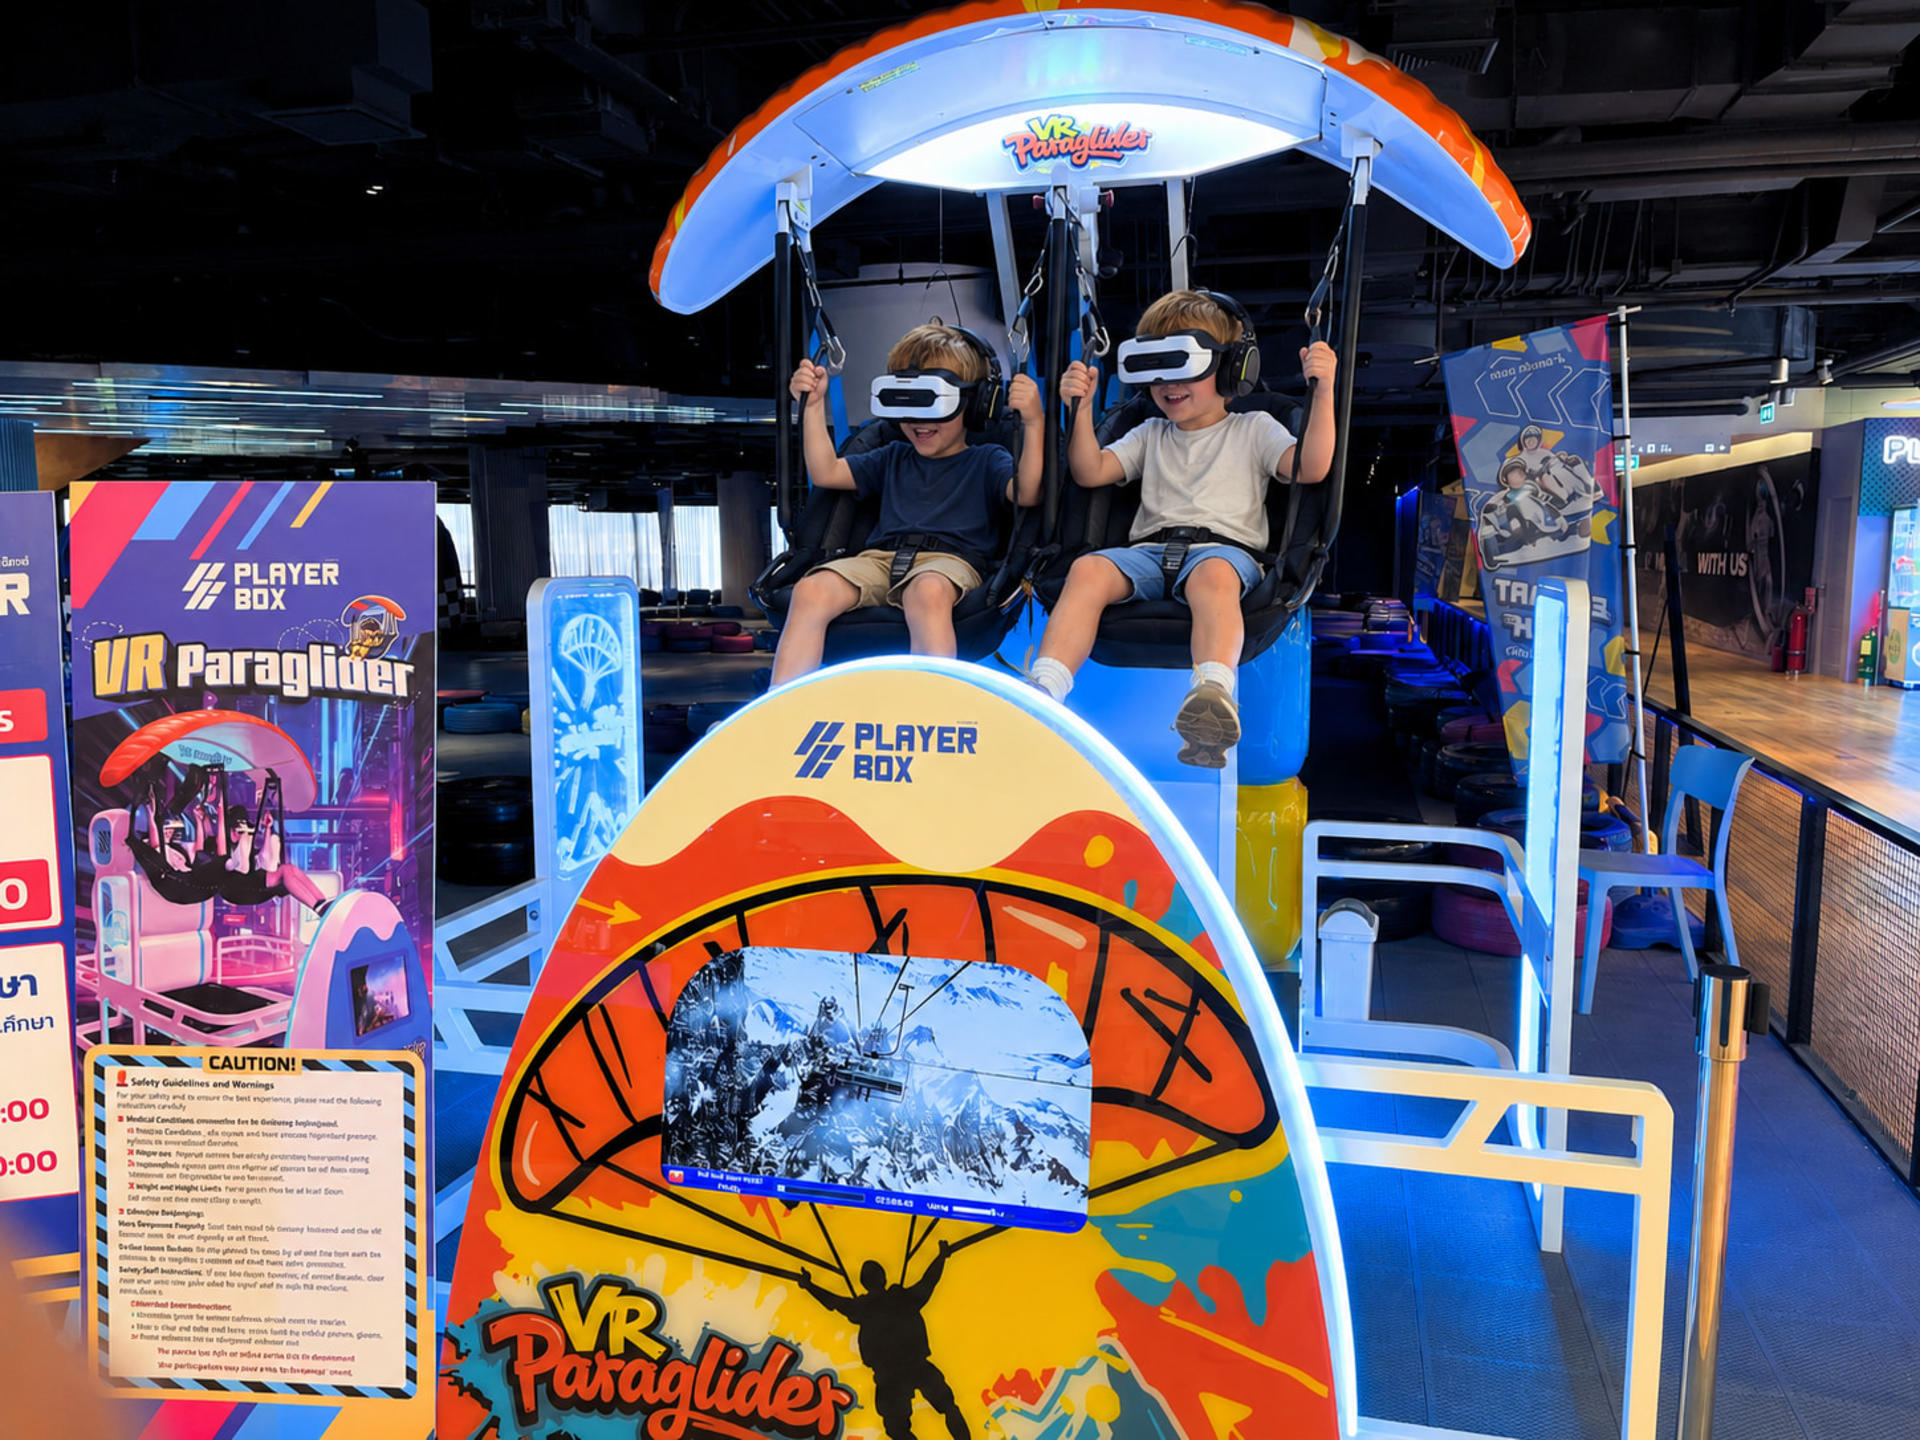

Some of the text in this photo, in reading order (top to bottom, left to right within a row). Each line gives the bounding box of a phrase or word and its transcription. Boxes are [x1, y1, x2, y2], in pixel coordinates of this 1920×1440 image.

[1028, 115, 1079, 139] VR
[1005, 121, 1153, 166] Paraglider
[233, 562, 340, 586] PLAYER
[1697, 552, 1748, 577] WITH US
[234, 588, 287, 611] BOX
[94, 634, 415, 698] VR Paraglider
[854, 722, 978, 754] PLAYER
[853, 754, 913, 783] BOX
[209, 1055, 296, 1072] CAUTION!
[130, 1077, 274, 1091] Safety Guidelines and Warnings
[548, 1283, 667, 1360] VR
[489, 1313, 853, 1440] Paraglider
